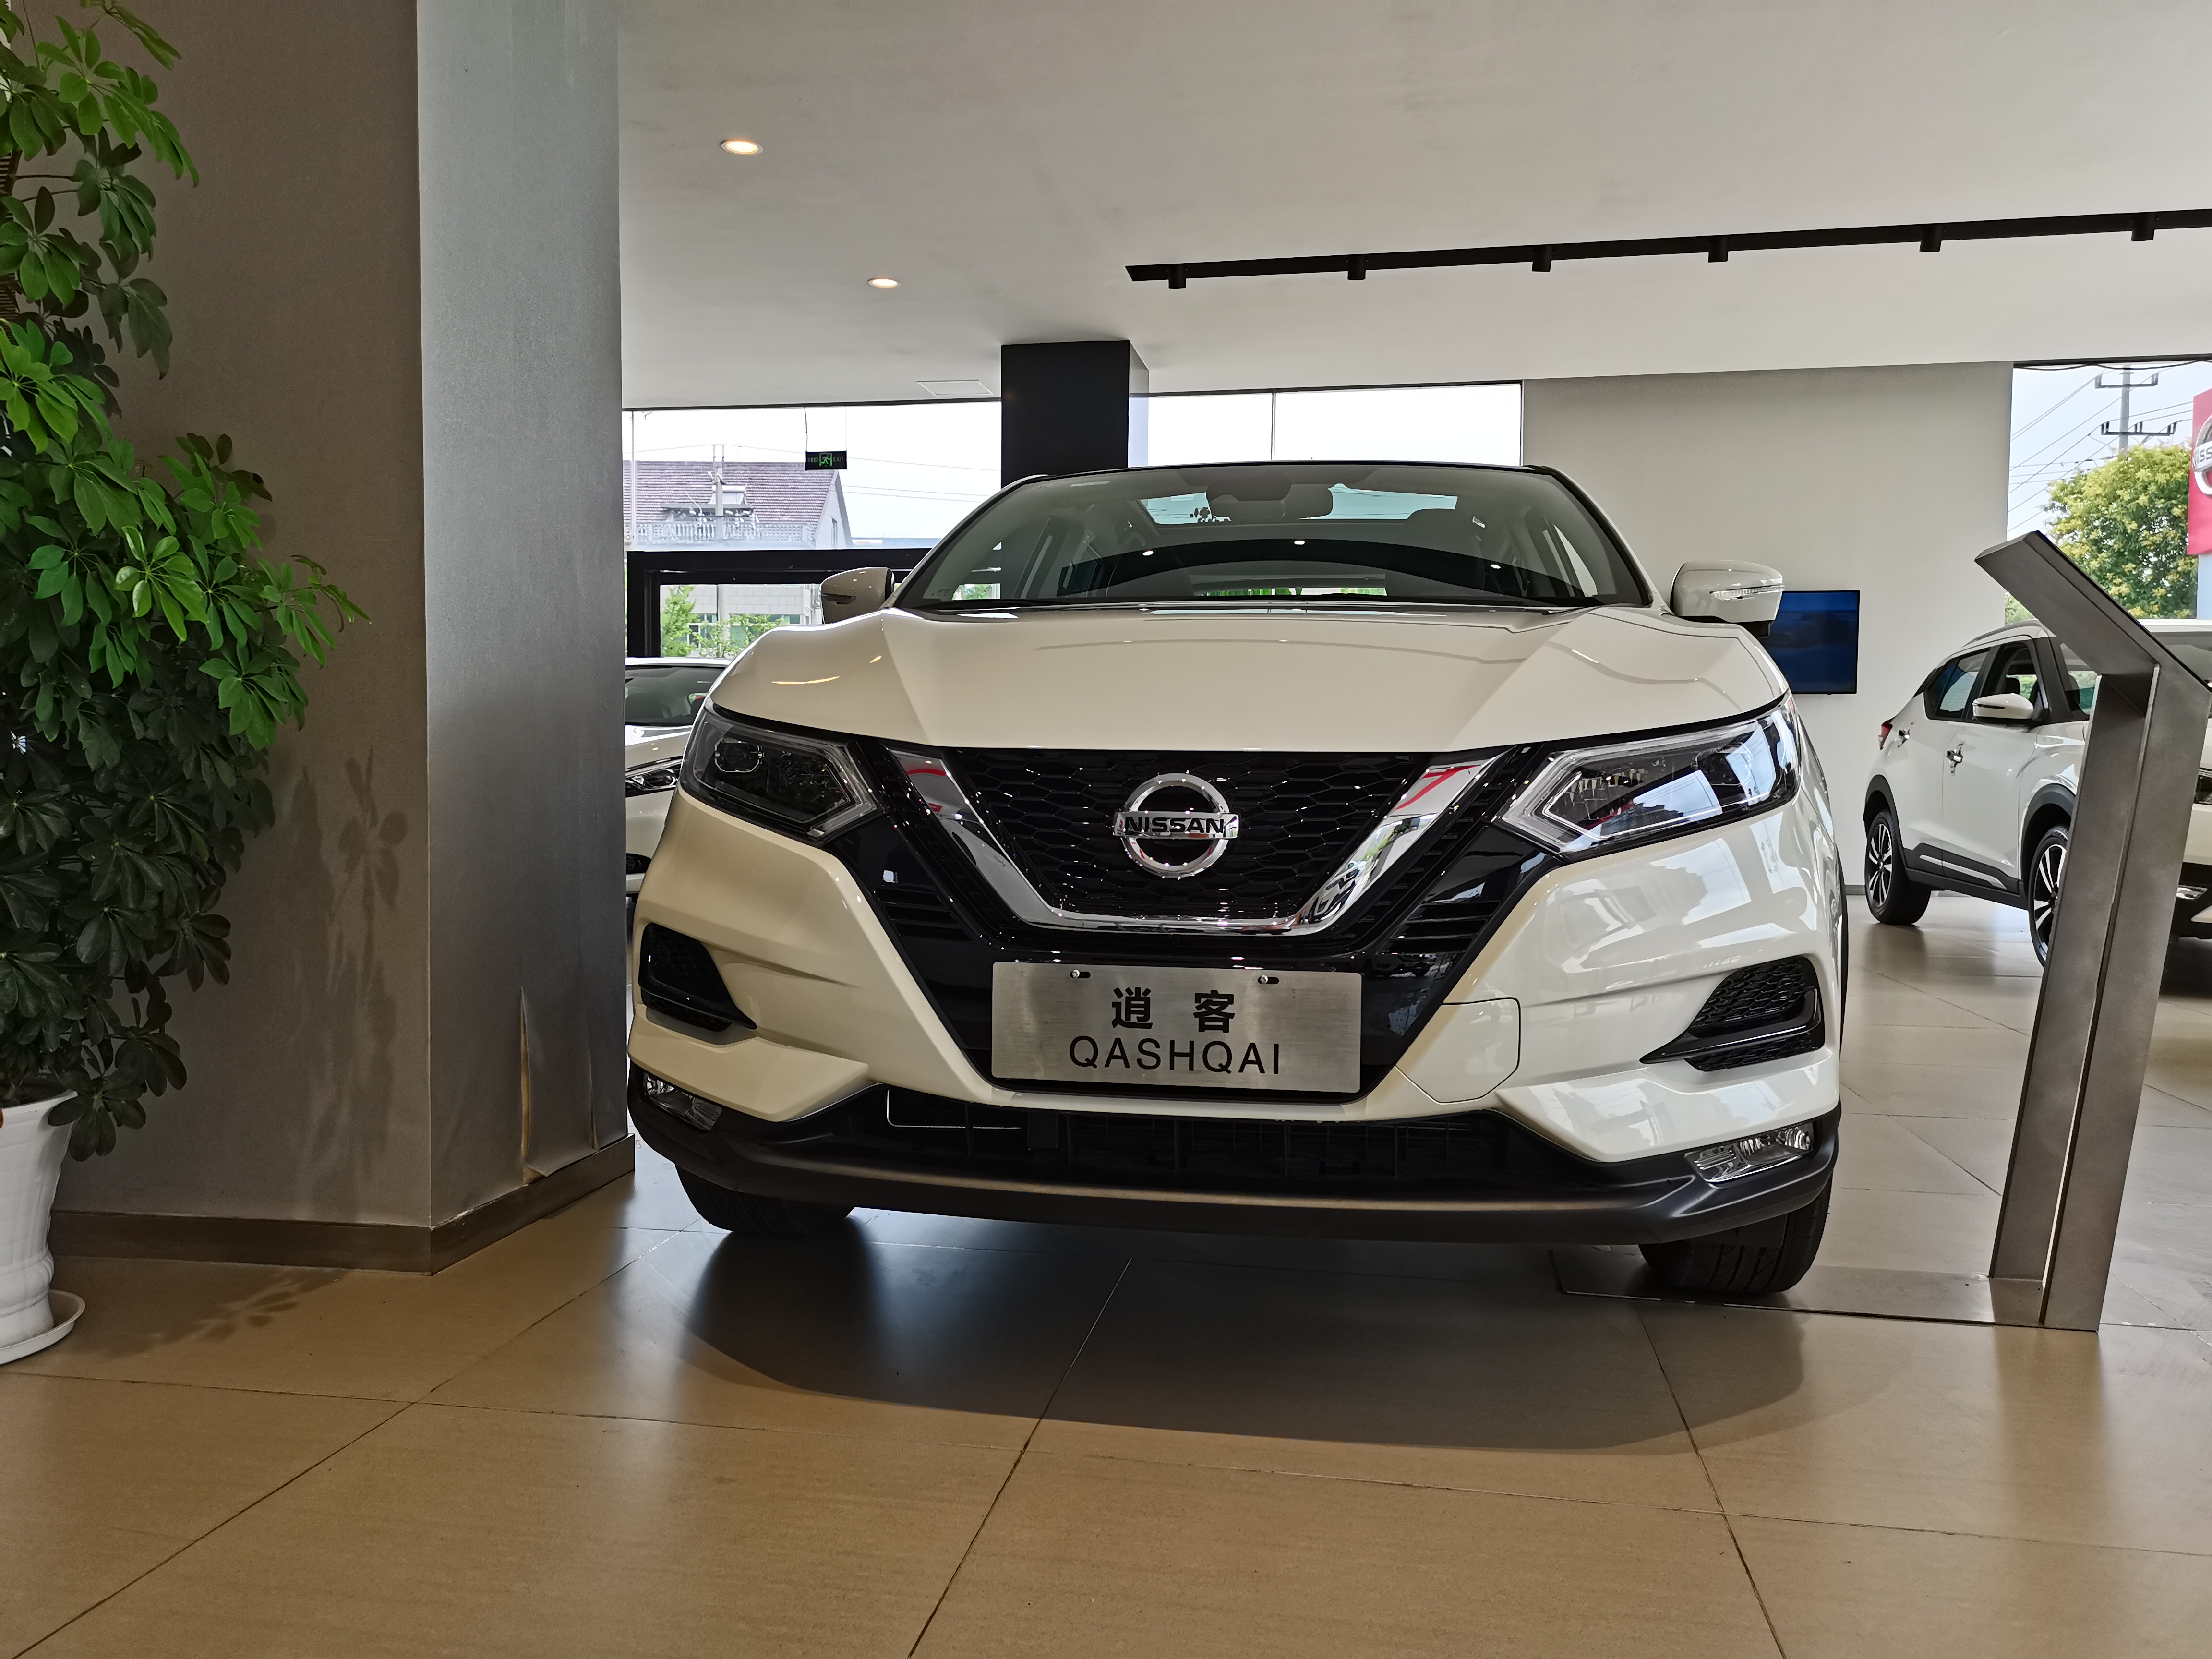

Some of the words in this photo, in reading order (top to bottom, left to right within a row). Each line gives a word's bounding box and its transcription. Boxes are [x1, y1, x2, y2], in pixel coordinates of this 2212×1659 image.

[1125, 817, 1224, 833] NISSAN
[1111, 987, 1236, 1033] 逍客
[1070, 1035, 1279, 1074] QASHQAI
